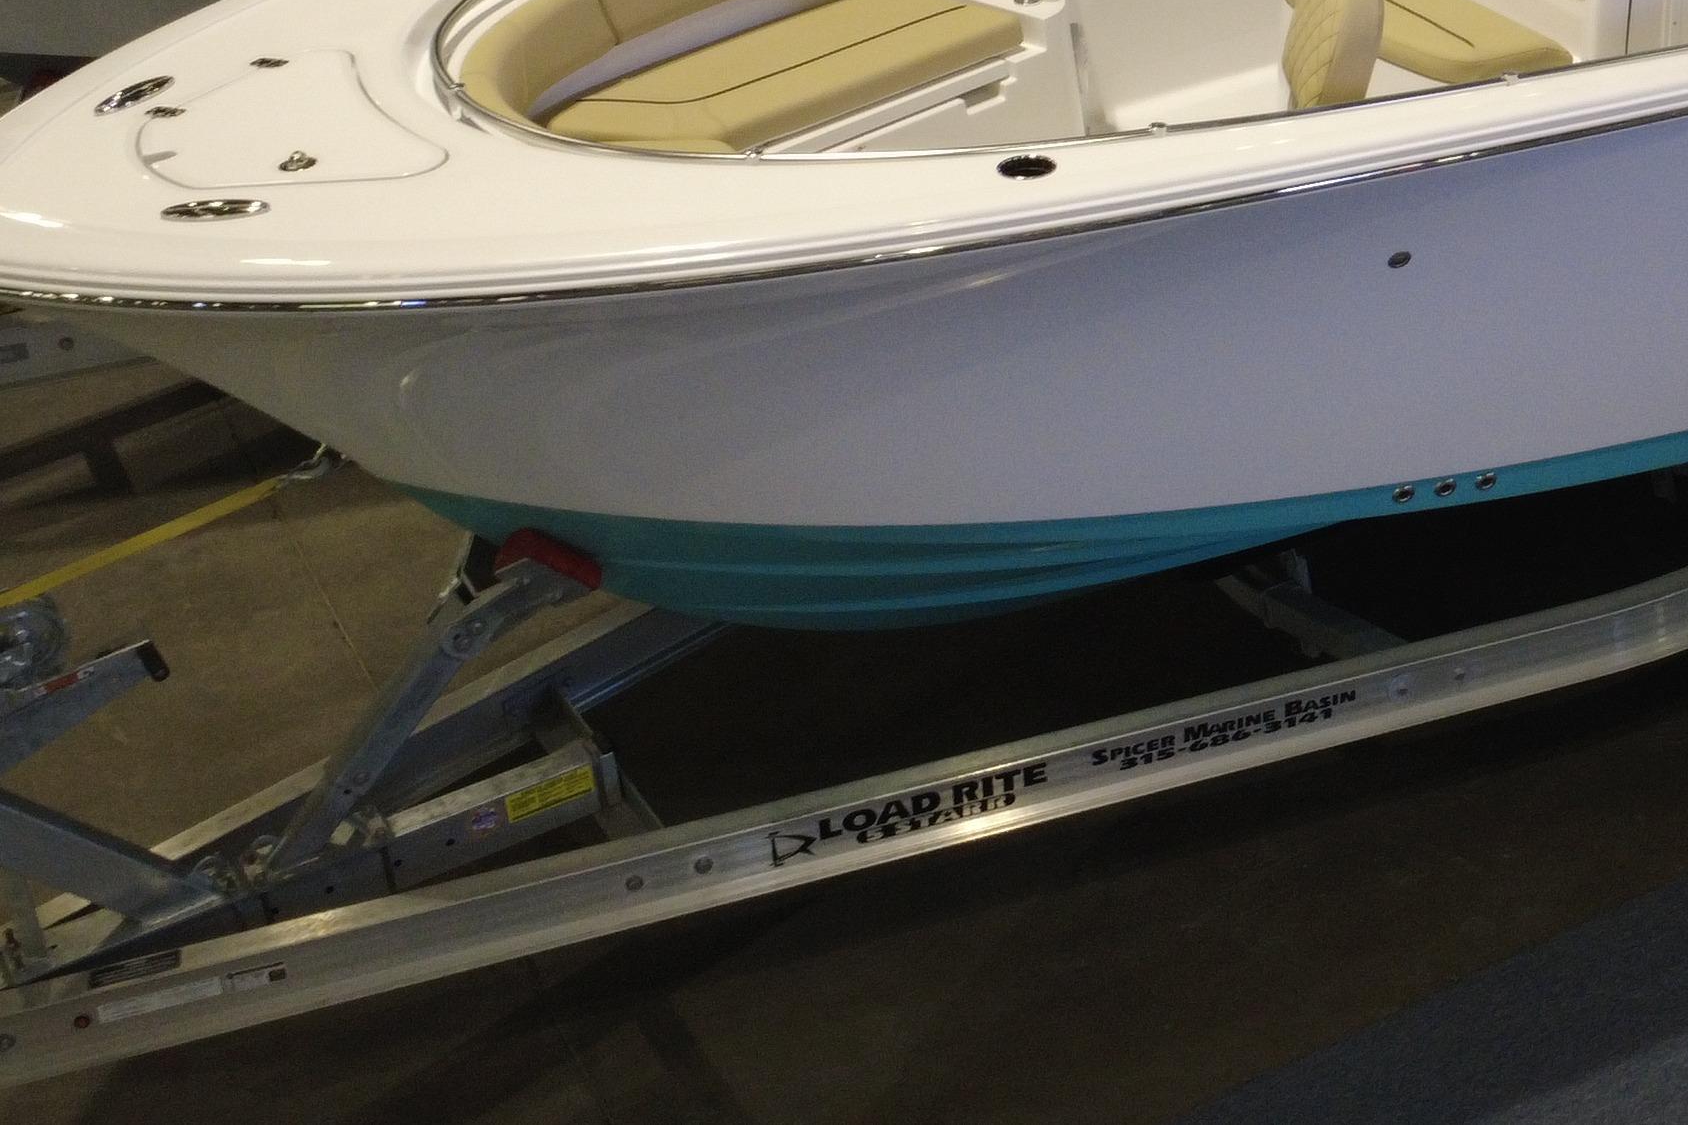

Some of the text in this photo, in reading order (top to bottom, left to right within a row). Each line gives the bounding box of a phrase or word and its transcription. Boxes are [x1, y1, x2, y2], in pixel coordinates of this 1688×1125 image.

[1091, 689, 1357, 767] SPICER MARINE BASIN
[1119, 707, 1334, 771] 315-686-3141
[818, 761, 1049, 841] LOAD RITE
